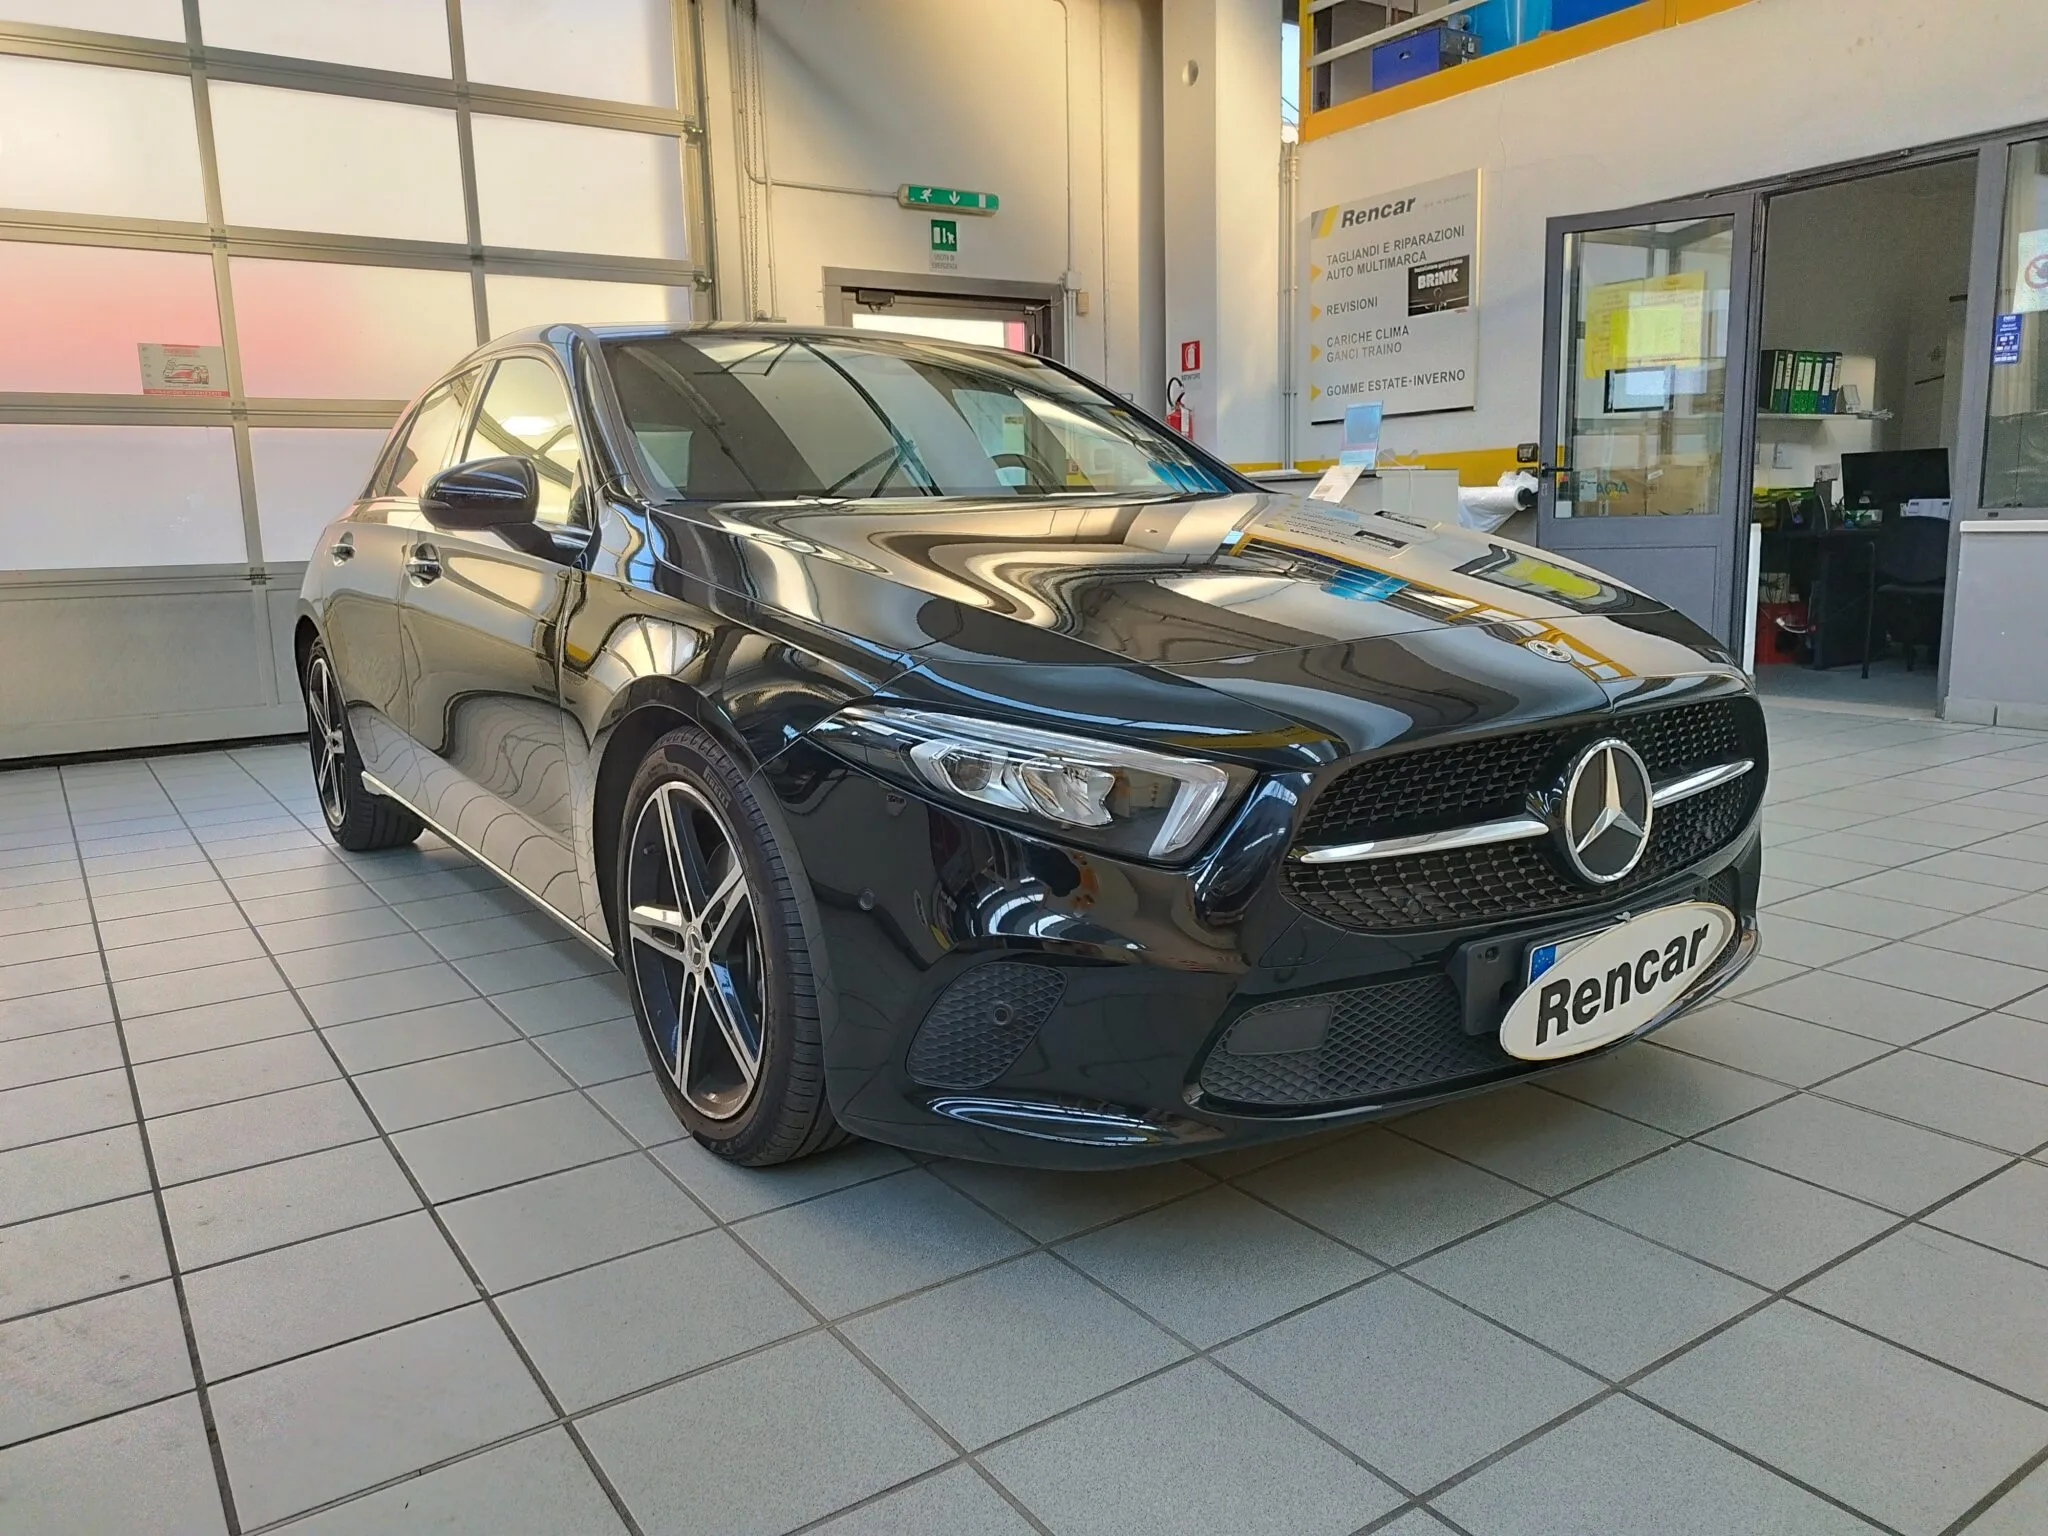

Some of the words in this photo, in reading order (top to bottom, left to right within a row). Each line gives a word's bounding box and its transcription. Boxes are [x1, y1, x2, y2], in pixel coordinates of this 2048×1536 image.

[1341, 197, 1416, 228] Rencar
[1327, 244, 1380, 266] TAGLIANDI
[1383, 242, 1390, 254] E
[1393, 224, 1465, 252] RIPARAZIONI
[1326, 265, 1354, 281] AUTO
[1357, 250, 1427, 275] MULTIMARCA
[1326, 296, 1378, 316] REVISIONI
[1326, 330, 1373, 348] CARICHE
[1375, 324, 1410, 341] CLIMA
[1326, 348, 1359, 363] GANCI
[1362, 341, 1402, 358] TRAINO
[1326, 381, 1365, 397] GOMME
[1535, 923, 1710, 1046] Rencar
